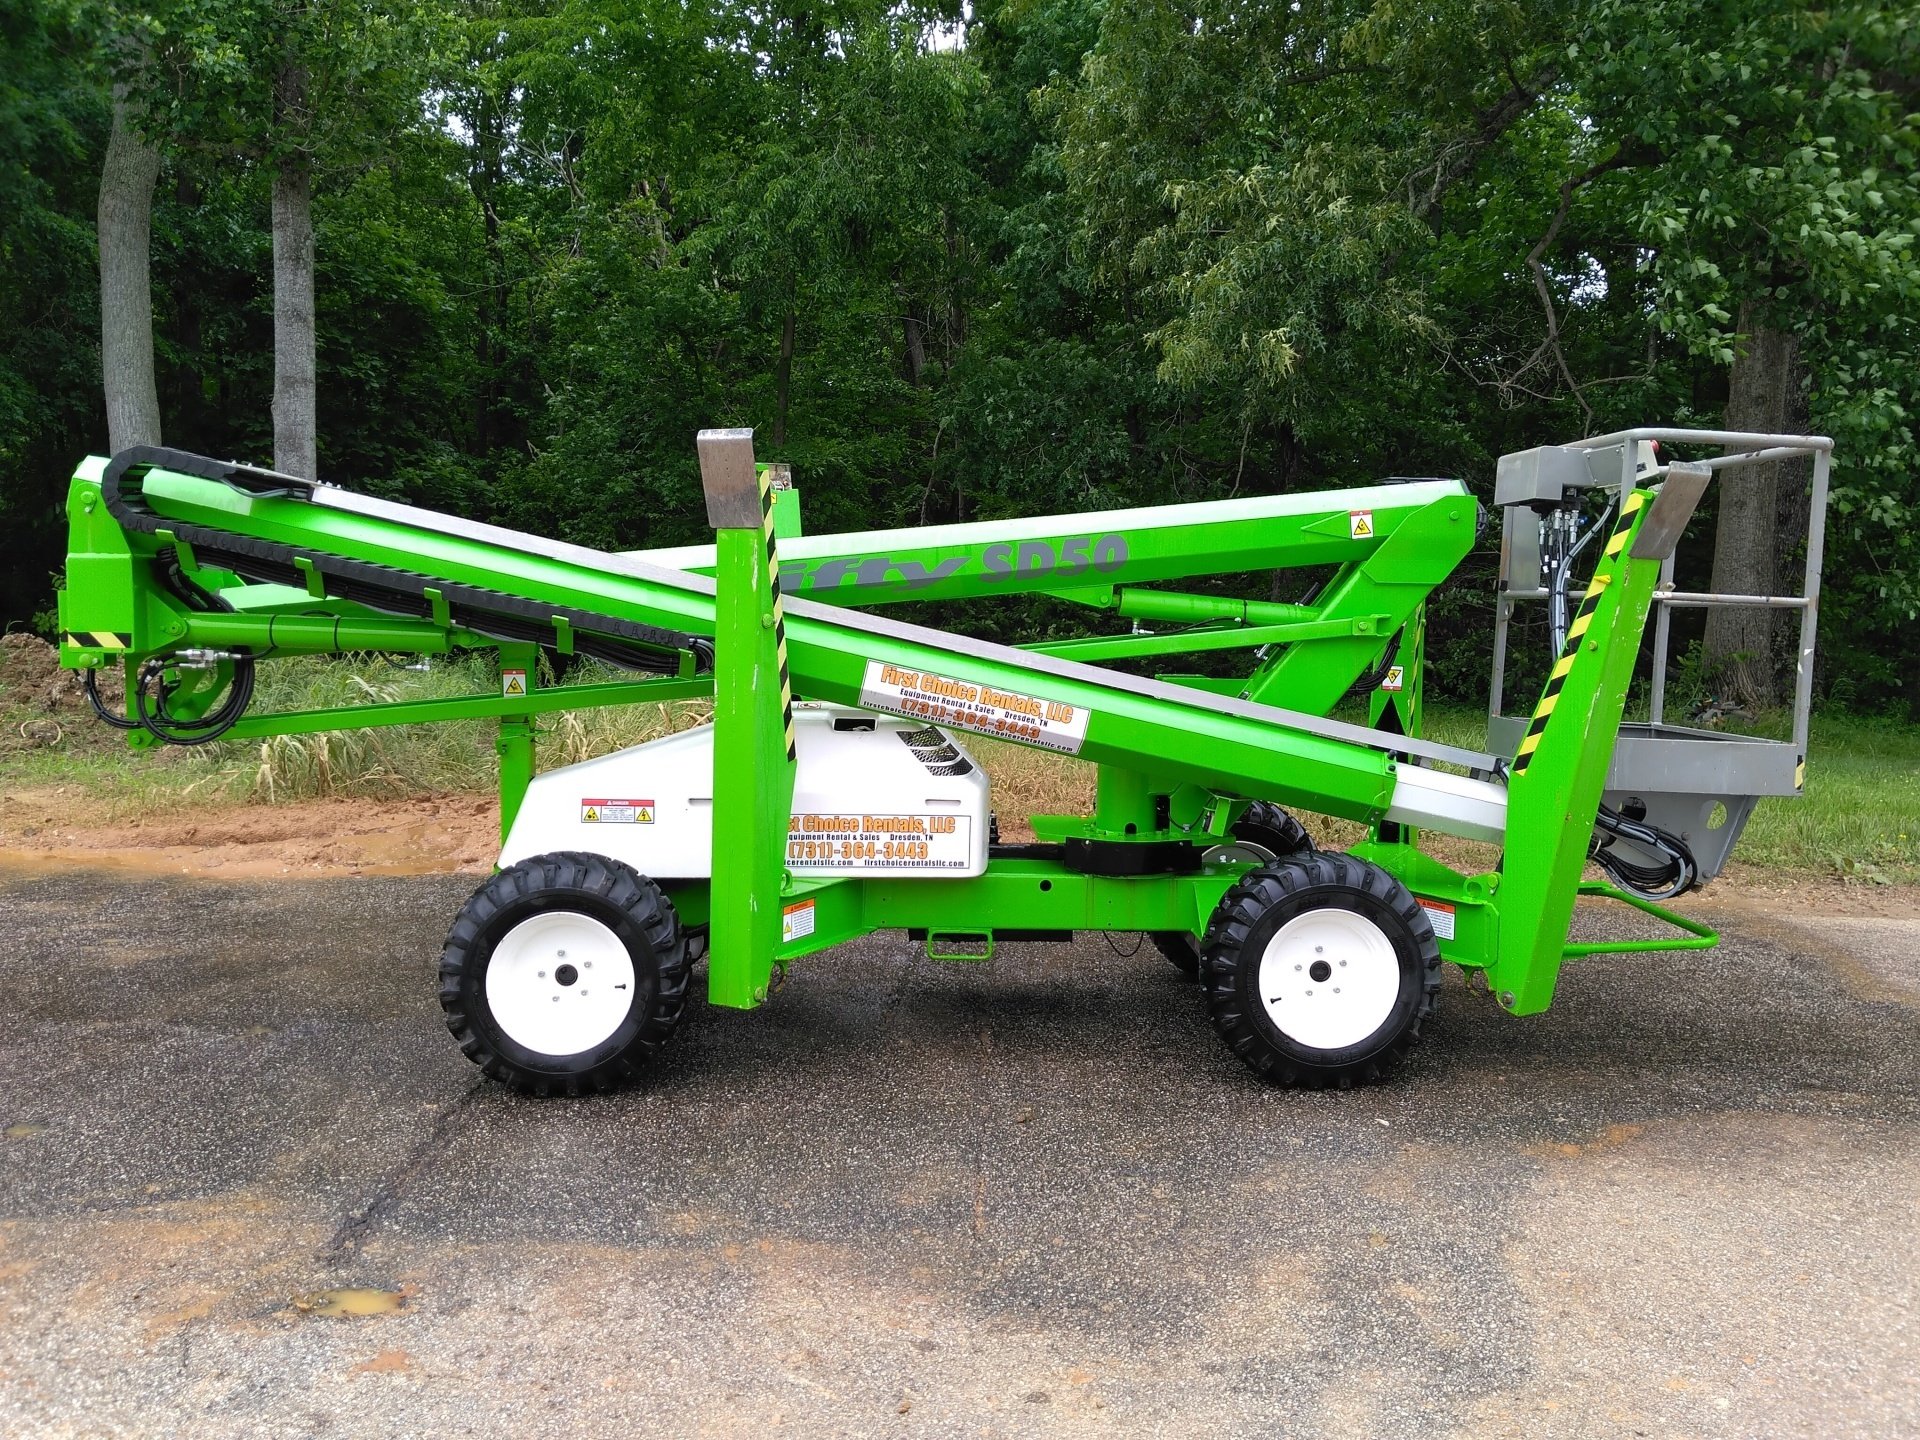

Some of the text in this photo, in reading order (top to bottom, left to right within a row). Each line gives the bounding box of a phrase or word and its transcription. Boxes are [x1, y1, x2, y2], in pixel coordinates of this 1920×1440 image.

[779, 535, 1129, 592] ifty SD50
[881, 665, 1073, 723] First Choice Rentals, LLC
[900, 688, 940, 703] Equipment
[941, 698, 966, 709] Rental
[974, 705, 995, 715] Sales
[863, 701, 963, 727] firstchoicerentalsllc.com
[901, 698, 1040, 739] (731)-364-3443
[1039, 719, 1049, 727] TN
[974, 725, 1073, 752] firstchoicerentalsllc.com
[787, 833, 824, 841] quipment
[826, 833, 850, 841] Rental
[803, 816, 859, 833] Choice
[862, 816, 927, 834] Rentals,
[930, 816, 955, 833] LLC
[789, 841, 928, 859] (731)-364-3443
[864, 859, 964, 867] firstchoicerentalsllc.com
